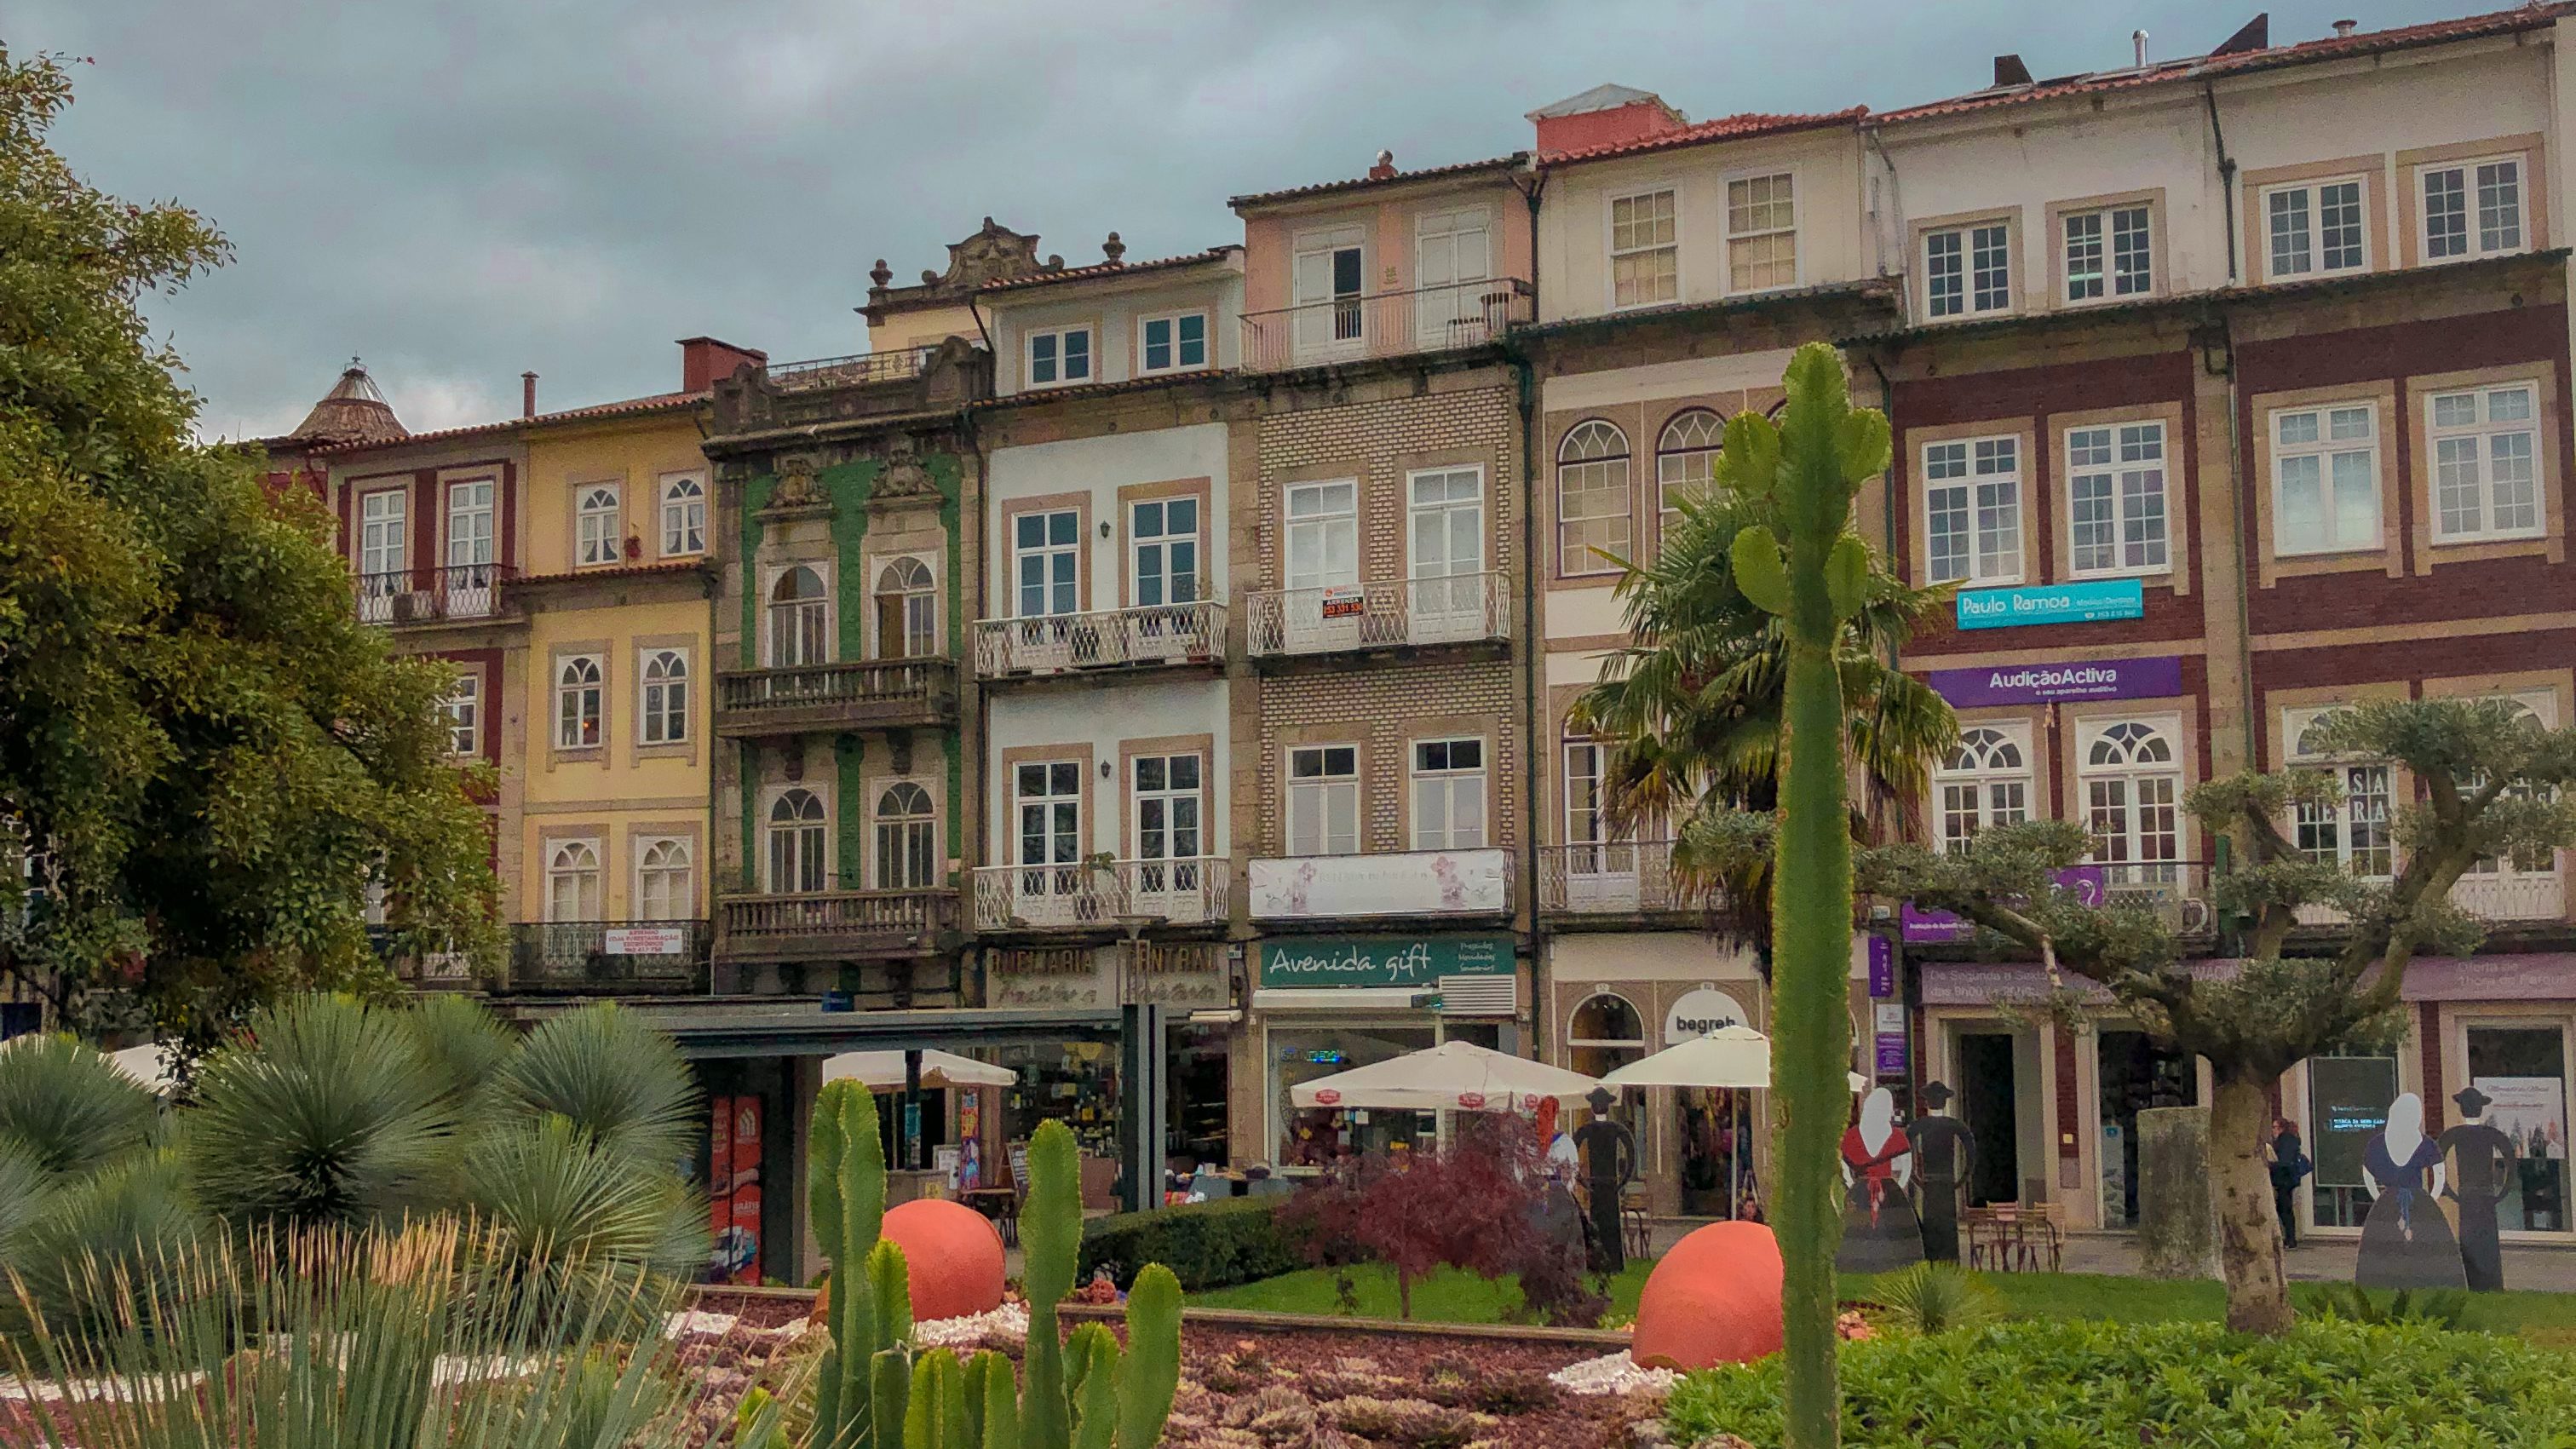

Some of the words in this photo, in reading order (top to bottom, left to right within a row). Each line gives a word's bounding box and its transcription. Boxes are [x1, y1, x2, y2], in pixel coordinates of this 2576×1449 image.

[1963, 595, 2006, 614] Paulo
[2013, 594, 2070, 612] Ramoa
[1989, 667, 2117, 688] AudiçãoActiva
[2088, 685, 2118, 693] auditivo
[1269, 945, 1376, 975] Avenida
[1385, 942, 1431, 981] gift
[1950, 969, 2001, 982] Segunda
